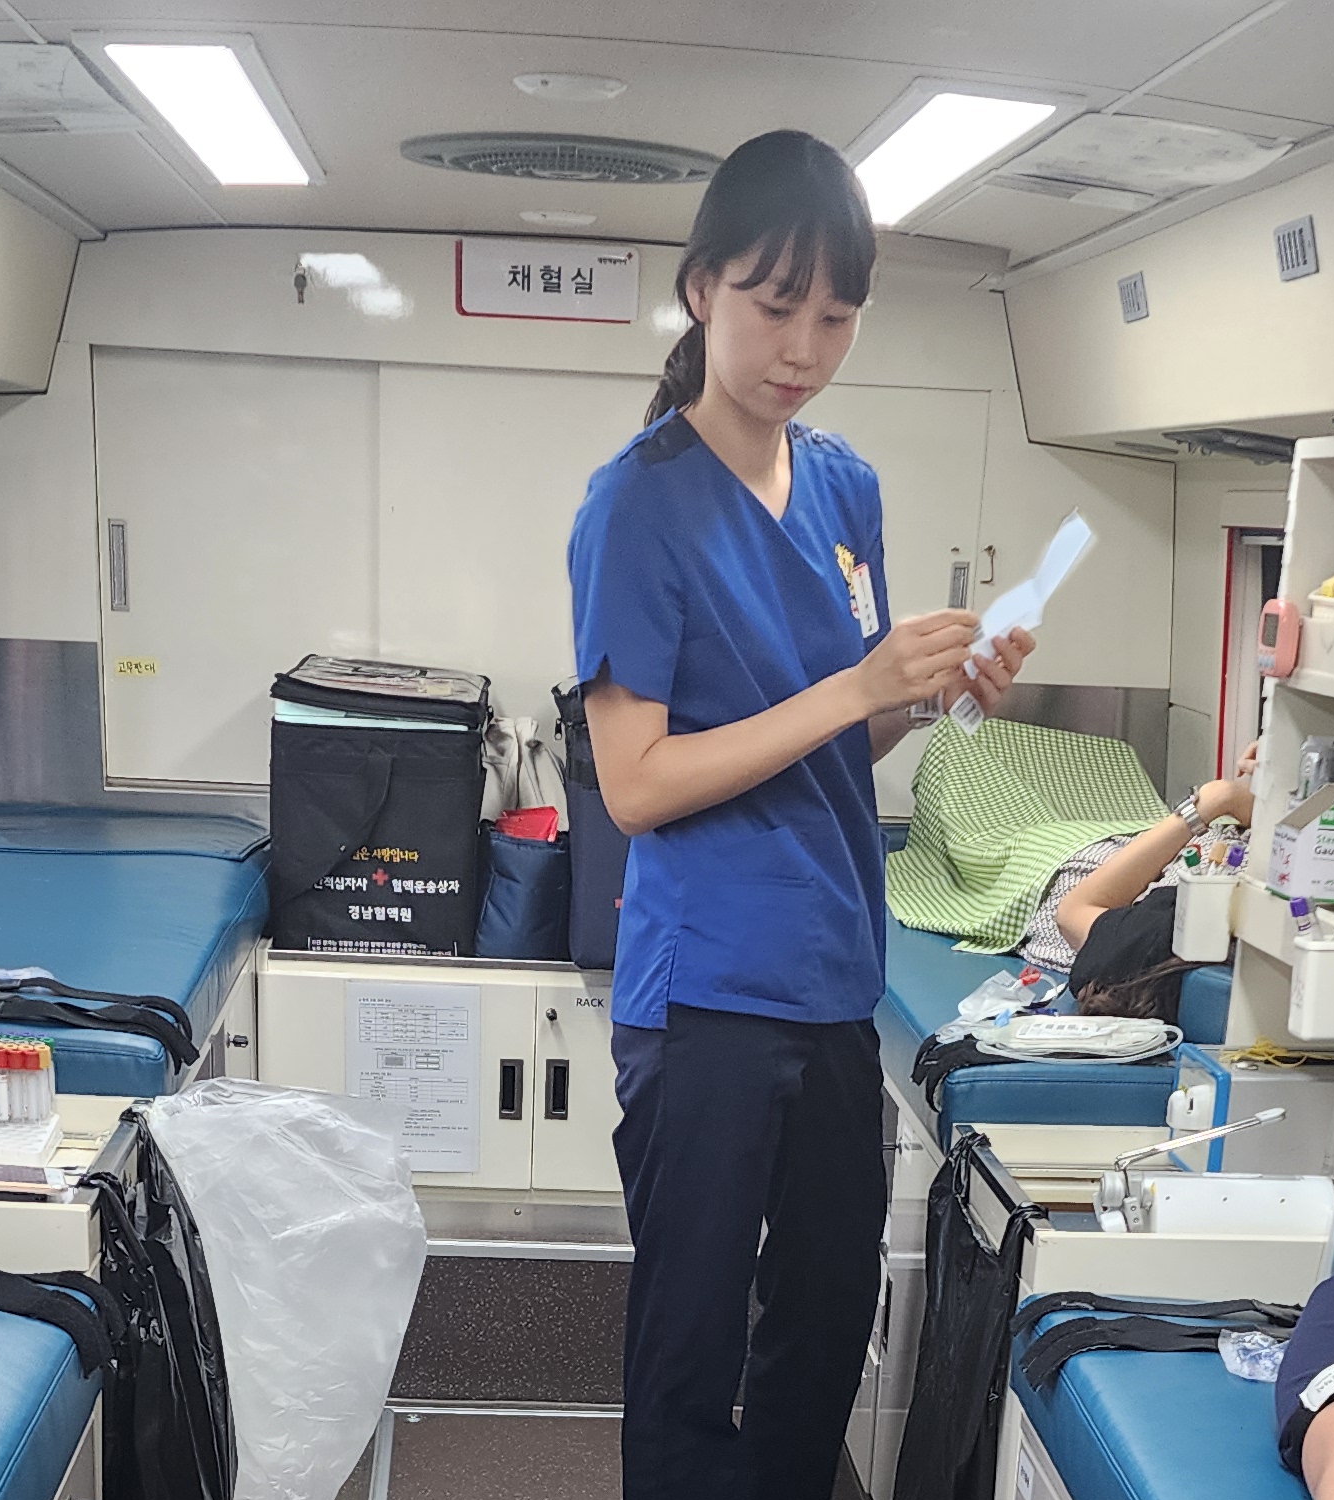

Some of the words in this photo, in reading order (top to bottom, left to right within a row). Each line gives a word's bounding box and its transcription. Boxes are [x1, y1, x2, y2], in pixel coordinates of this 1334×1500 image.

[508, 264, 593, 295] 채혈실
[372, 847, 419, 863] 사랑입니다
[348, 905, 412, 922] 경남혈액원
[576, 997, 604, 1008] RACK
